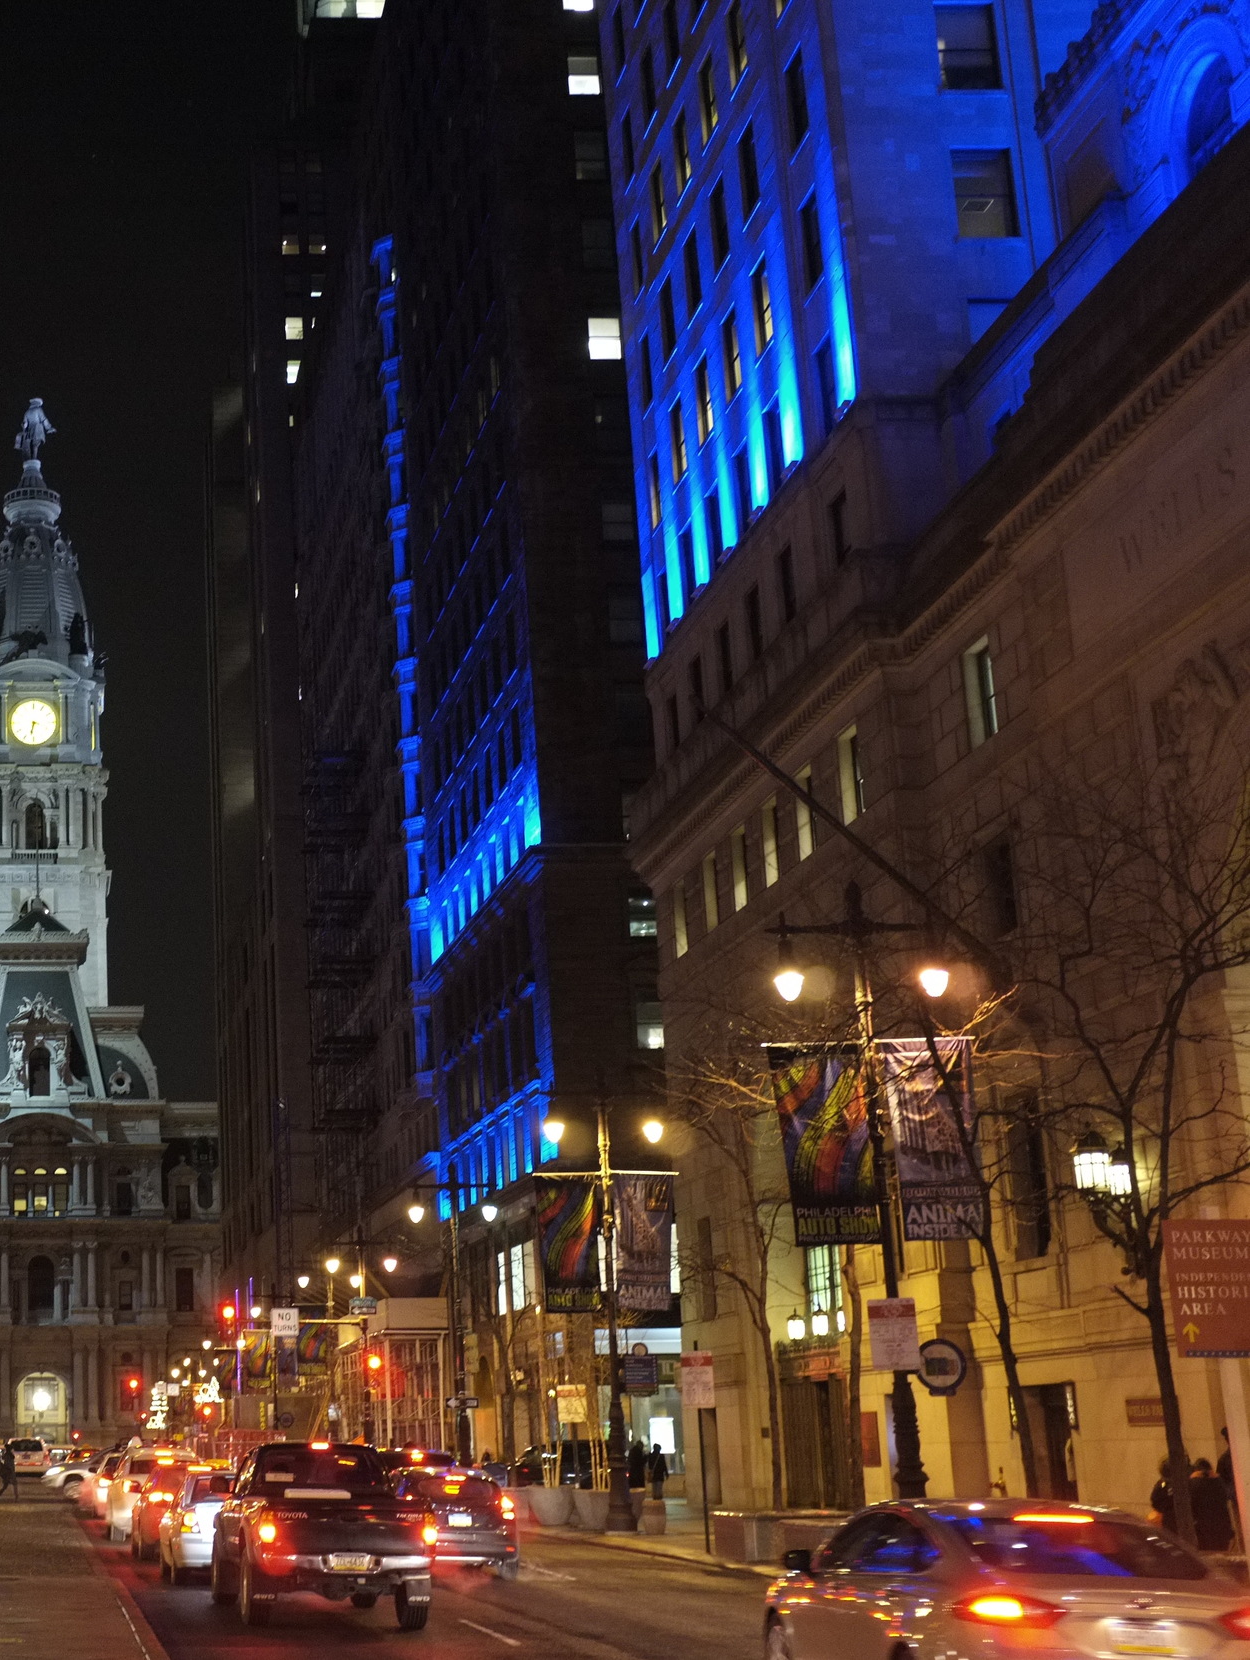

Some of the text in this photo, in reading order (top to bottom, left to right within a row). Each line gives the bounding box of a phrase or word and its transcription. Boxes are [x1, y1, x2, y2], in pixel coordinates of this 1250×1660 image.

[798, 1216, 880, 1235] AUTO SHOW
[907, 1223, 958, 1239] INSIDE
[1171, 1230, 1250, 1243] PARKWAY
[619, 1284, 669, 1299] ANIMAL
[1180, 1302, 1227, 1315] AREA
[278, 1312, 291, 1321] NO
[273, 1324, 298, 1332] TURNS
[276, 1511, 309, 1519] TOYOTA
